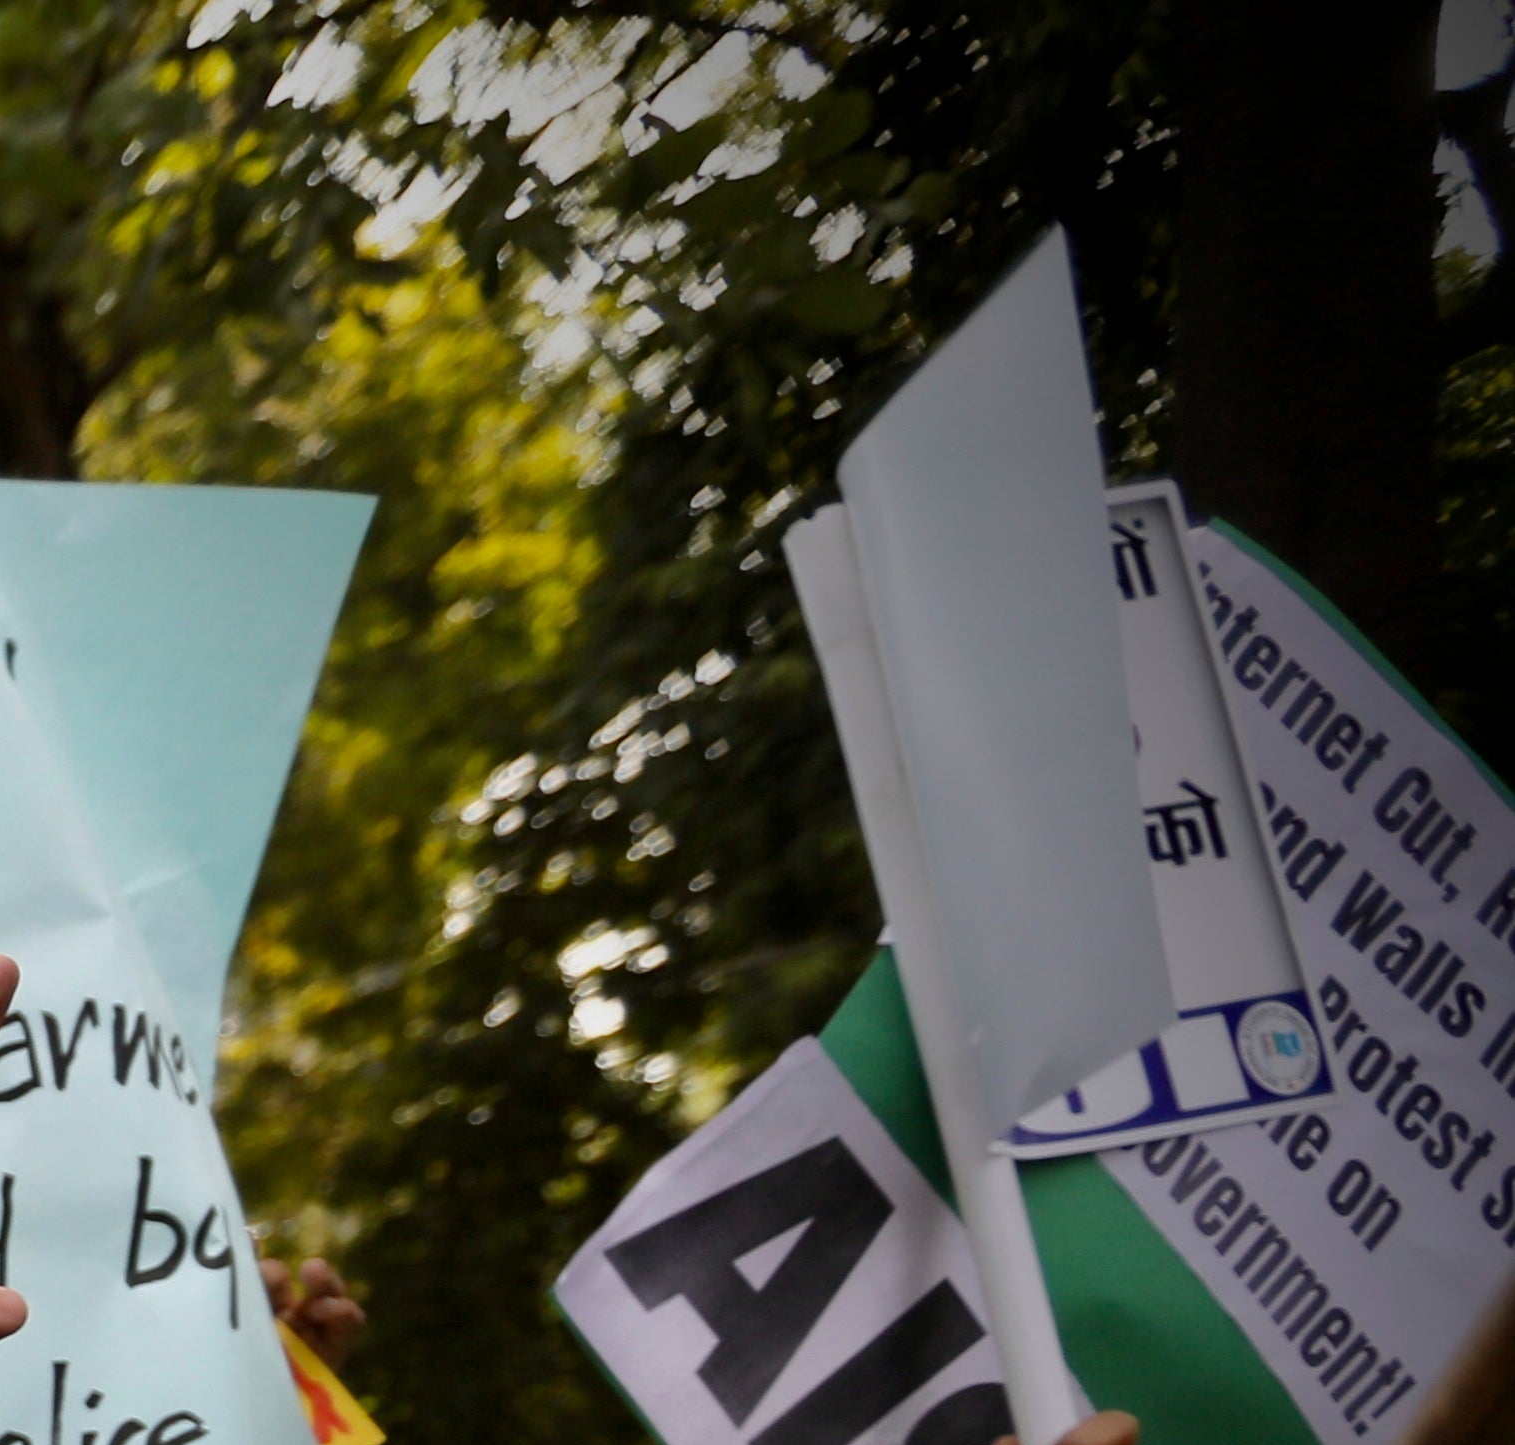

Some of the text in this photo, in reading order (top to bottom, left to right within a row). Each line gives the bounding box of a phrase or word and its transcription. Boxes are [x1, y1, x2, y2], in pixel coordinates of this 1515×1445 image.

[1198, 560, 1391, 796] nternet
[1372, 765, 1479, 903] Cut,
[1329, 868, 1488, 1039] Walls
[124, 1156, 240, 1331] by
[1120, 1134, 1419, 1439] overnment!
[1326, 1157, 1403, 1253] on
